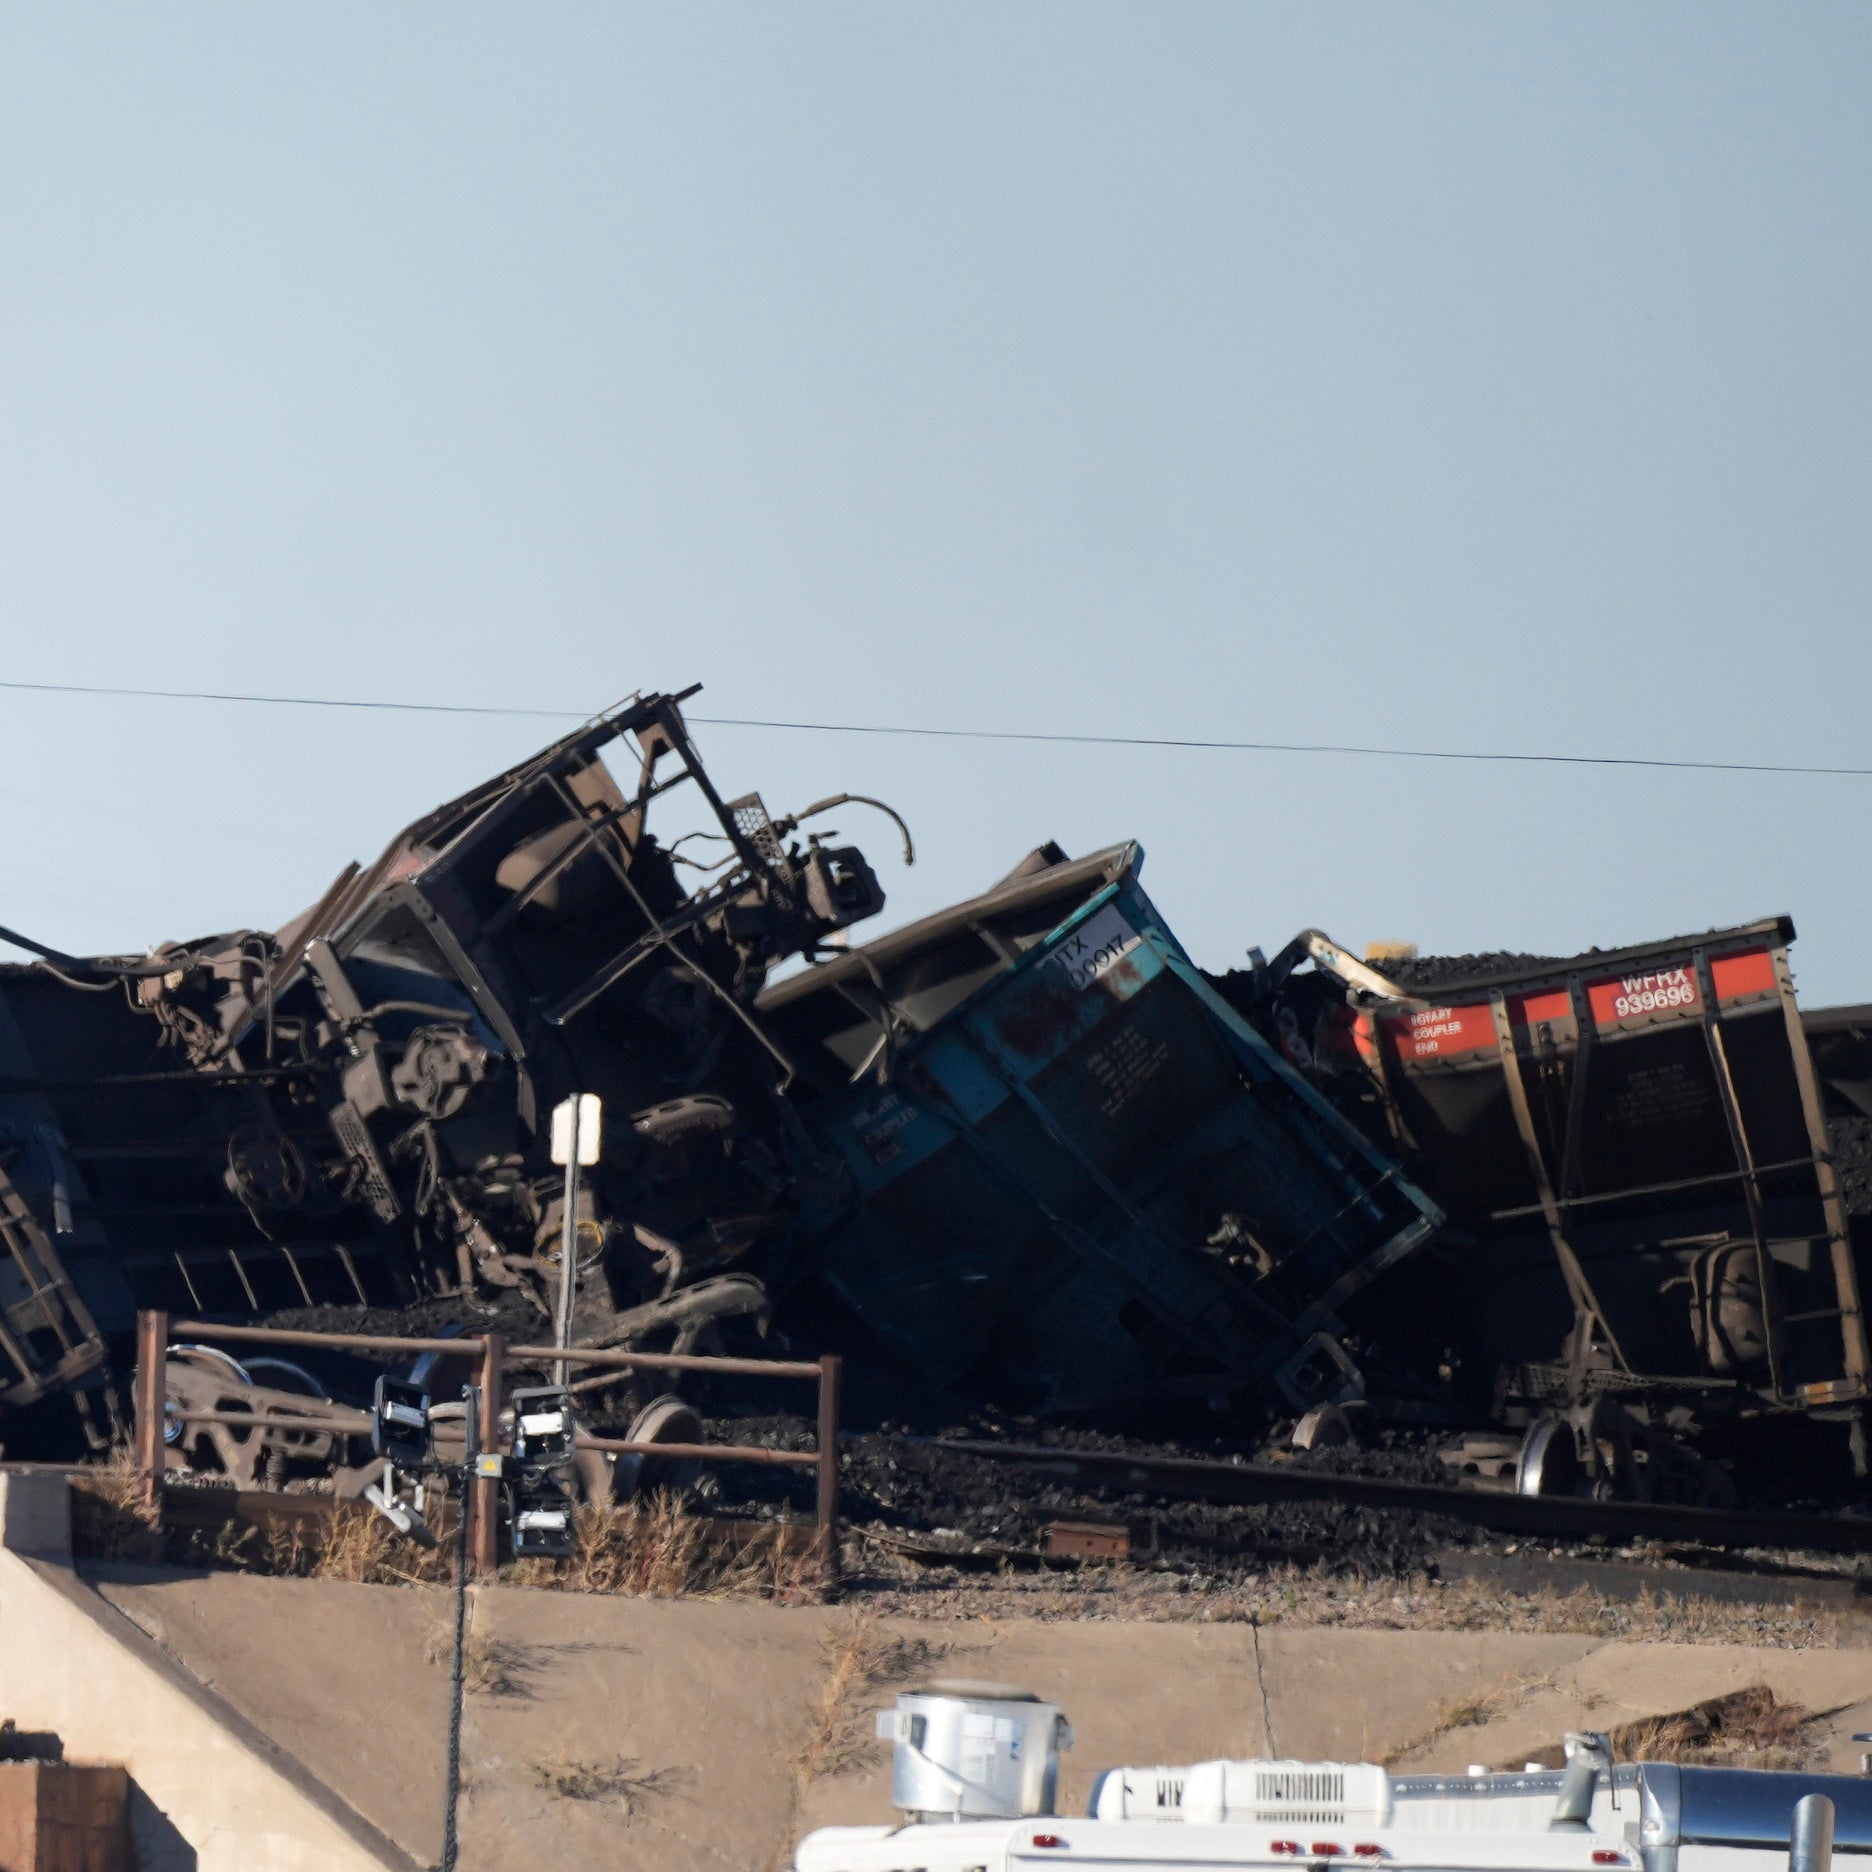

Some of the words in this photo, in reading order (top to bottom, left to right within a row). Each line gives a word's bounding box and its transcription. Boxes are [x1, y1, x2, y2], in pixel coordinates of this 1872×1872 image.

[1053, 935, 1089, 968] ITX
[1068, 934, 1125, 985] 00017
[1621, 967, 1688, 994] WFRX
[1615, 983, 1695, 1017] 939696
